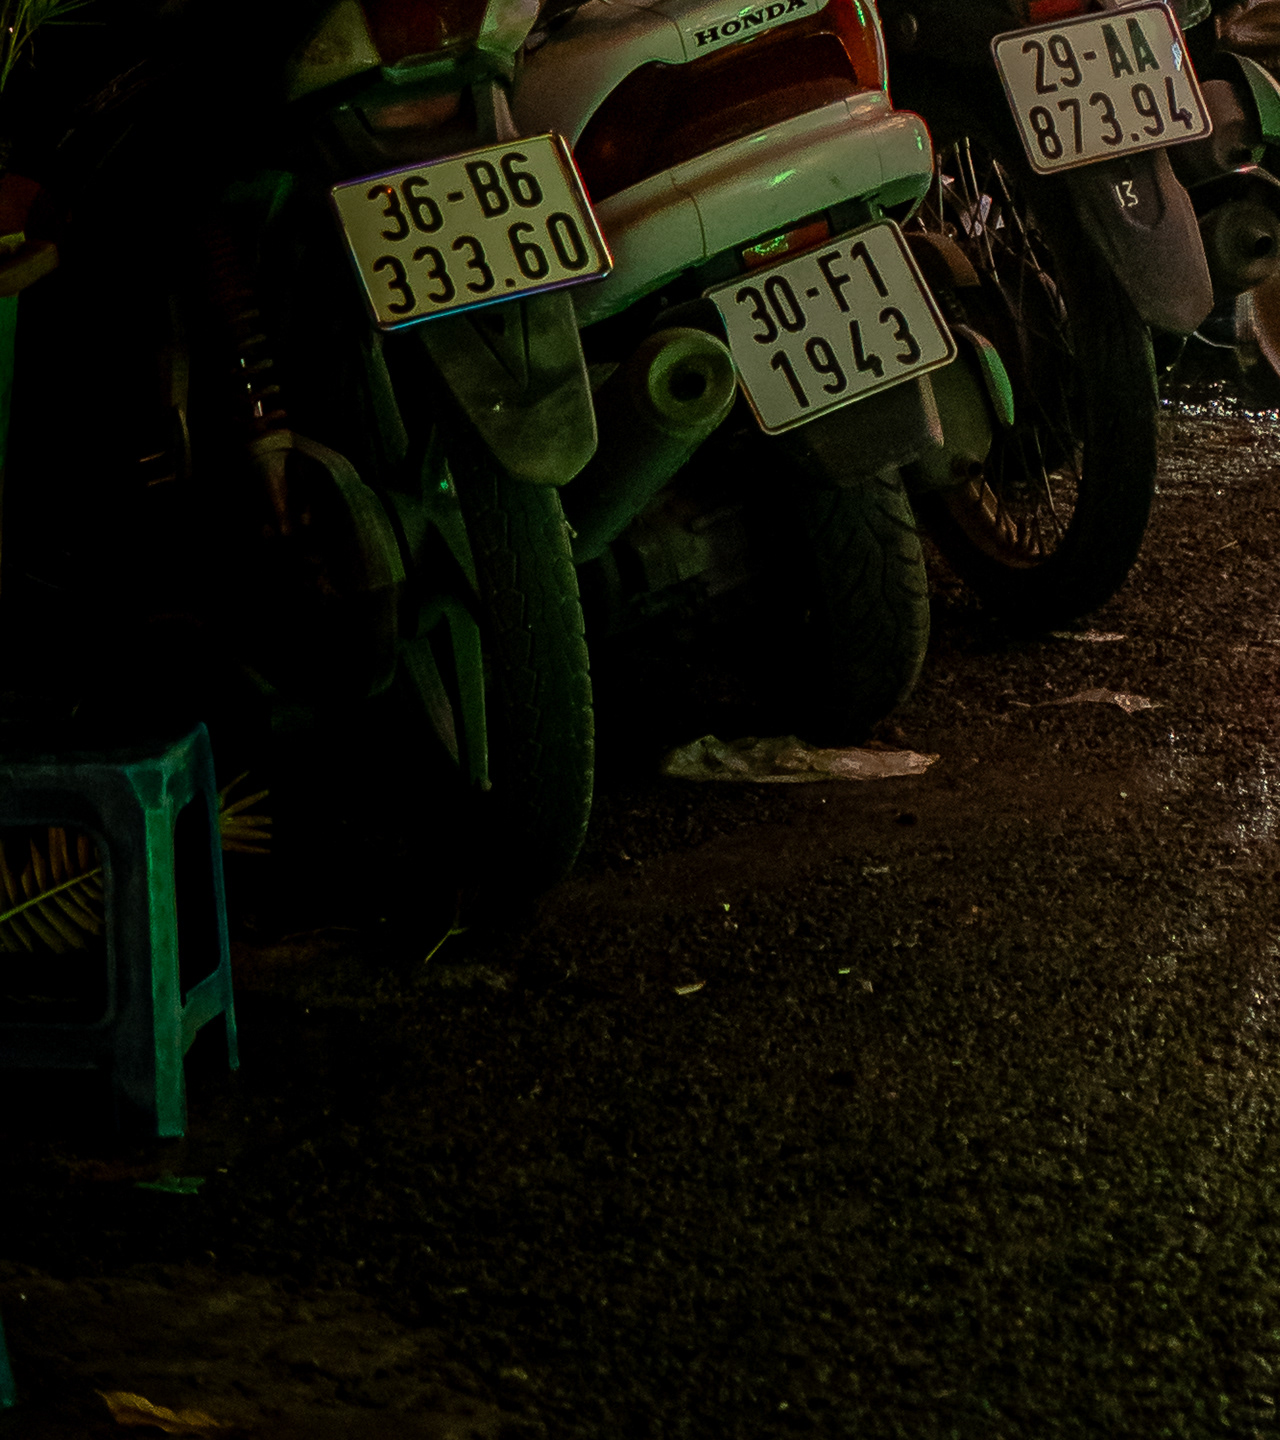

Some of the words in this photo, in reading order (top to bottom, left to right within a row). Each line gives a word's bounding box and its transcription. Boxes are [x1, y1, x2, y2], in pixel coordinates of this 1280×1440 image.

[1022, 17, 1160, 96] 29-AA
[1029, 76, 1194, 160] 873.94
[366, 151, 544, 244] 36-B6
[372, 211, 589, 317] 333.60
[735, 238, 891, 346] 30-F1
[769, 305, 923, 411] 1943
